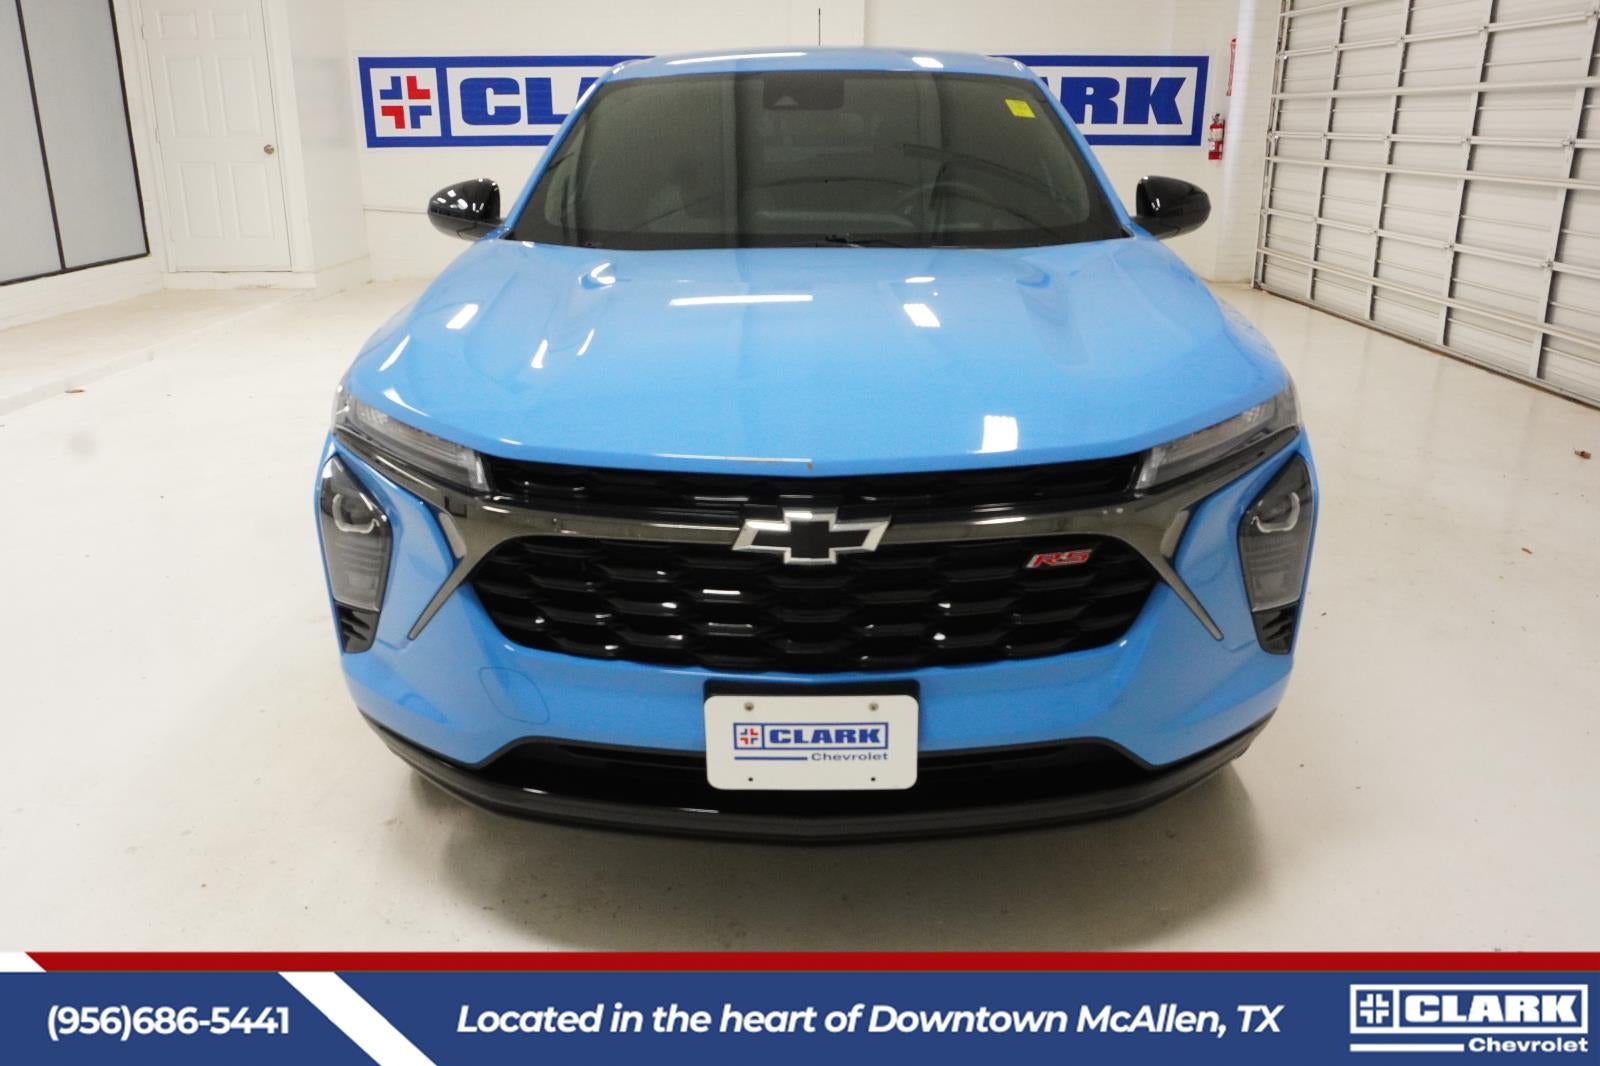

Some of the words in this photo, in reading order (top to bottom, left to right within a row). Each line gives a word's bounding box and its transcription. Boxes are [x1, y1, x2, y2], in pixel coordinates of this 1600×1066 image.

[1026, 549, 1093, 568] RS
[768, 729, 881, 744] CLARK
[811, 752, 889, 762] Chevrolet
